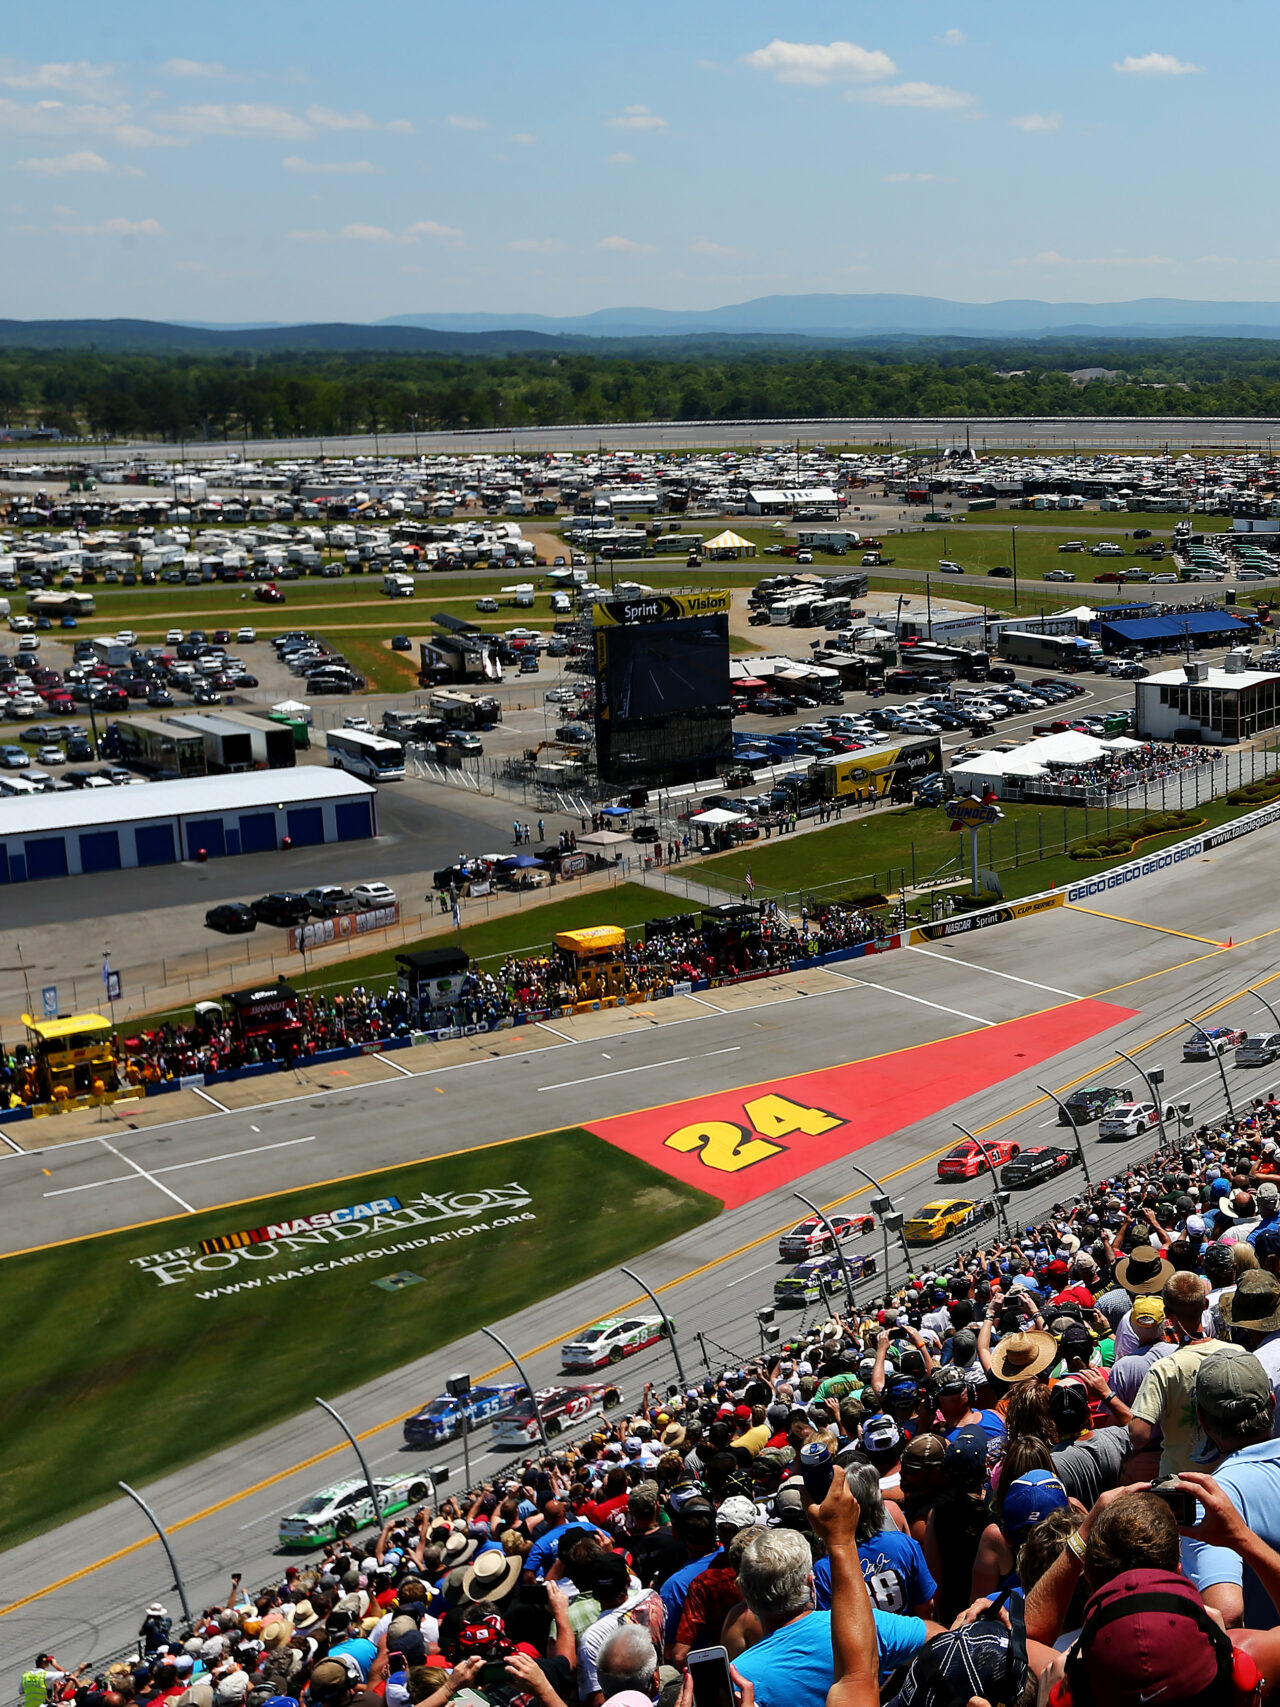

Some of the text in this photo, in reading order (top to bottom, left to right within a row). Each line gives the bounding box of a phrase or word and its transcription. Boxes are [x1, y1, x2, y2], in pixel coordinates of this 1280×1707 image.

[624, 597, 726, 619] Sprint Vision
[907, 754, 927, 769] Sprint
[949, 806, 995, 821] SUNOCO
[1068, 843, 1201, 902] GEICO GEICO GEICO GEICO
[945, 898, 1056, 935] NASCAR Sprint CUP SERIES
[250, 1000, 287, 1015] BRANDT
[437, 1021, 489, 1041] GEICO
[663, 1093, 850, 1173] 24
[990, 1149, 1001, 1163] 51
[963, 1209, 975, 1225] 34
[129, 1198, 394, 1269] THE NASCAR
[141, 1182, 530, 1287] FOUNDATION
[195, 1211, 537, 1300] WWW.NASCARFOUNDATION.ORG
[631, 1326, 649, 1347] 38
[482, 1399, 500, 1418] 35
[569, 1399, 588, 1419] 23
[1028, 1511, 1041, 1521] 2
